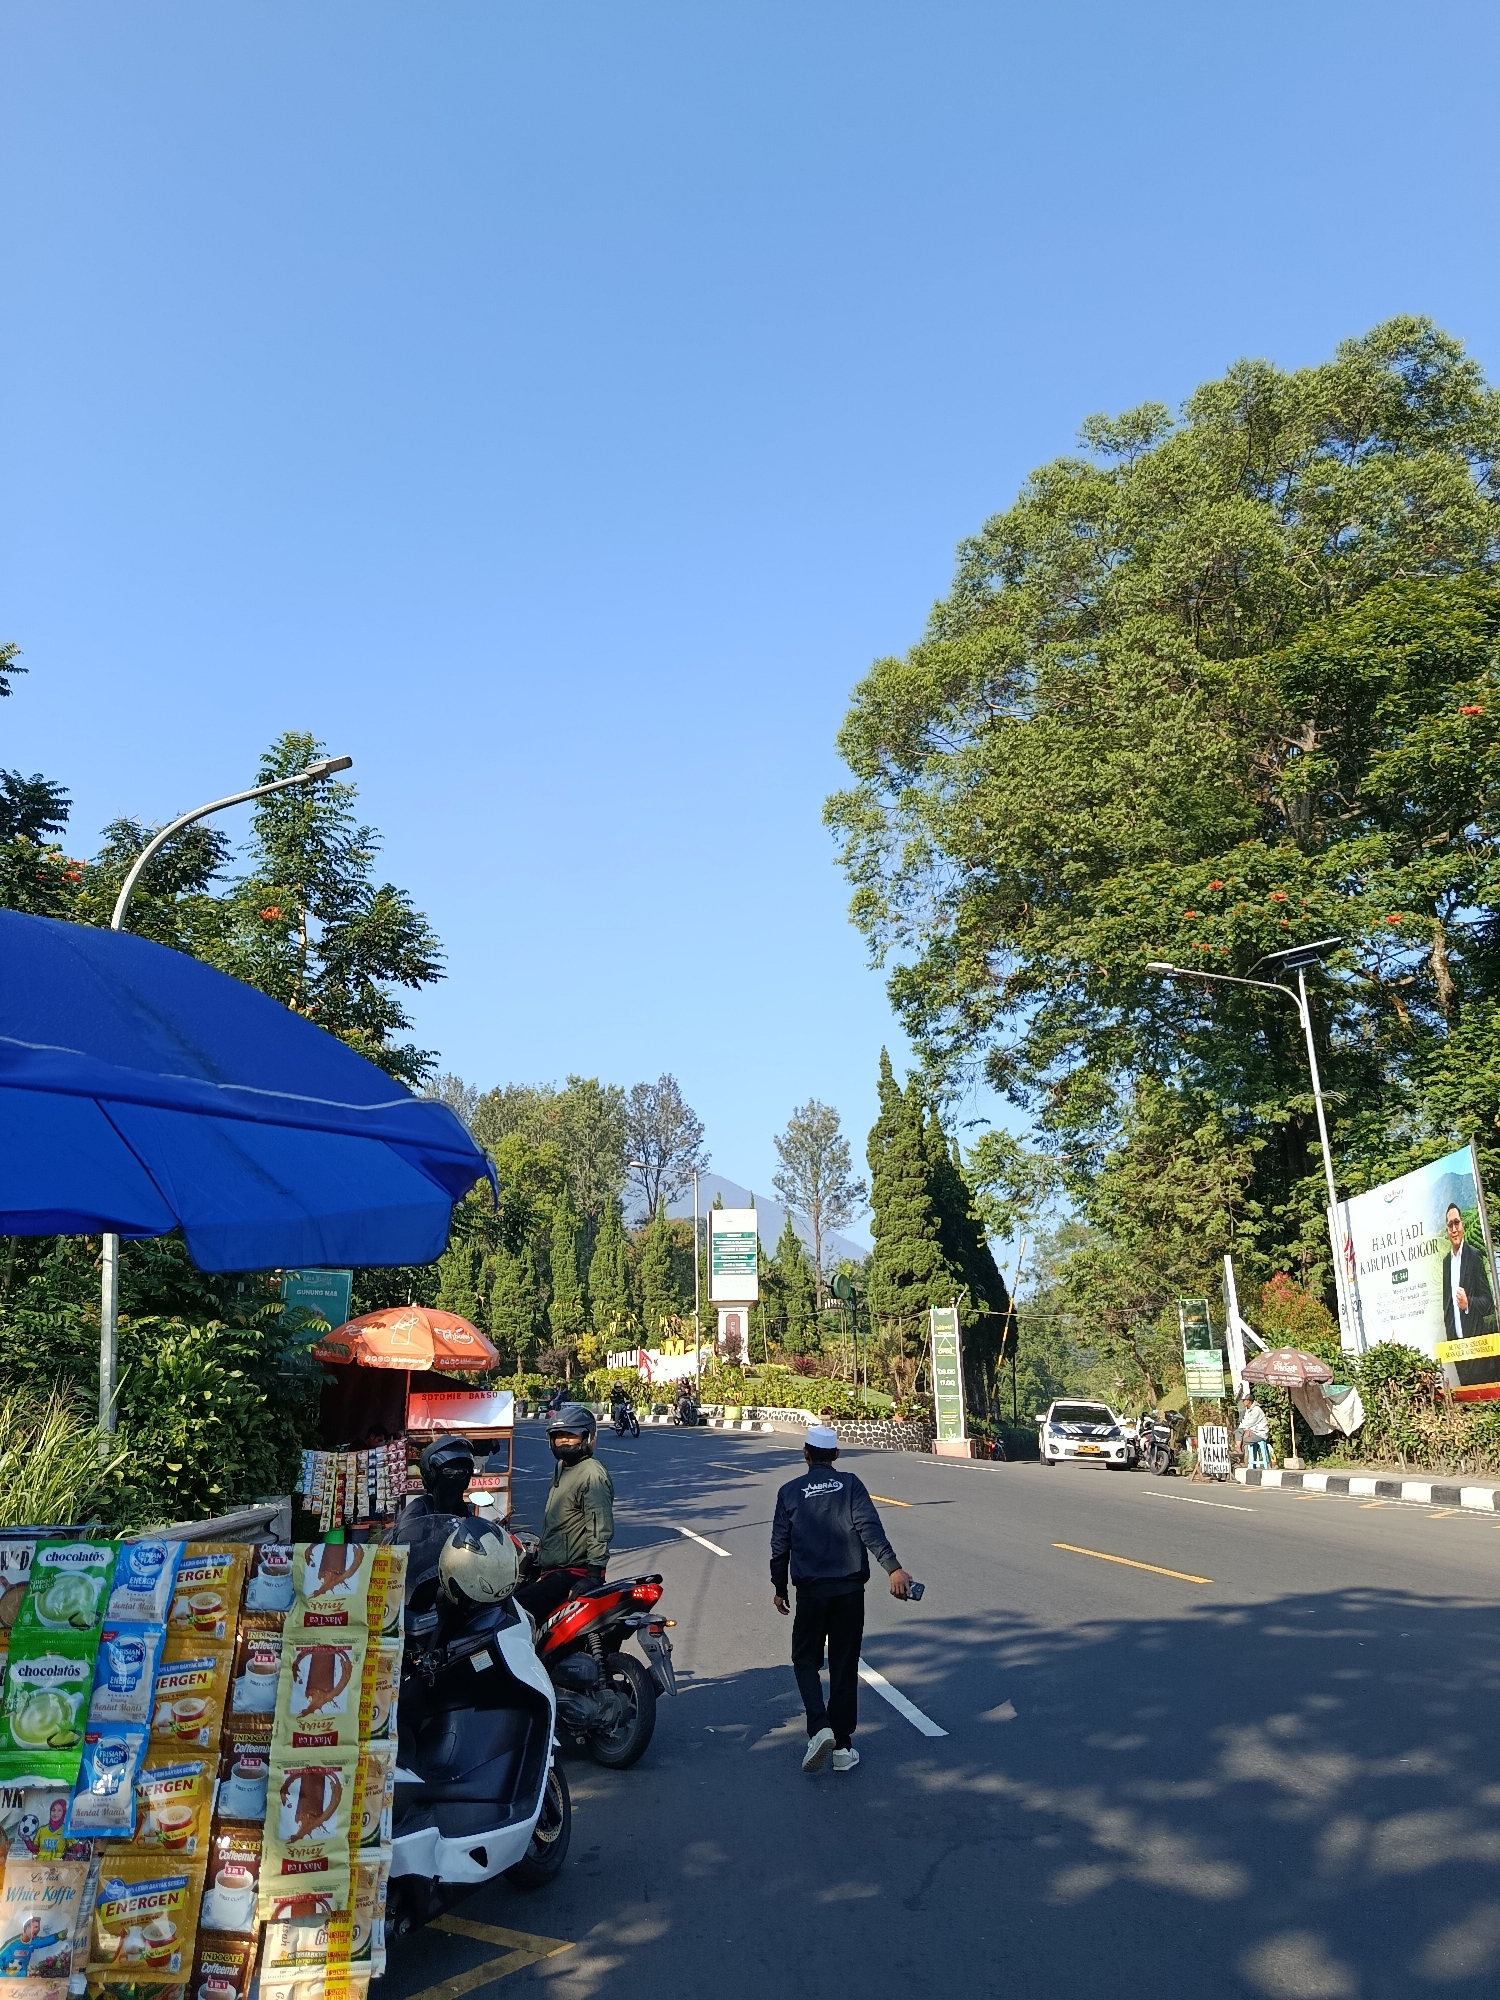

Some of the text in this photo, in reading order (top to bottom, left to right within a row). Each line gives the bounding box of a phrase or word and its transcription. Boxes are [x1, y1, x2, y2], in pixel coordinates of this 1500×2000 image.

[1372, 1222, 1424, 1251] HARI JADI
[1408, 1238, 1439, 1262] BOGOR
[607, 1350, 639, 1370] Gunu
[138, 1551, 162, 1559] FRISIAN
[177, 1568, 224, 1583] ERGEN
[116, 1648, 141, 1656] FRISIAN
[248, 1640, 282, 1651] Coffeemi
[156, 1672, 208, 1689] ERGEN
[233, 1733, 272, 1742] INDOCAF
[135, 1778, 194, 1798] NERGEN
[219, 1850, 256, 1862] Coffeemix
[6, 1885, 77, 1904] White Koffie
[105, 1891, 180, 1918] ENERGEN
[201, 1962, 240, 1976] Coffeemix
